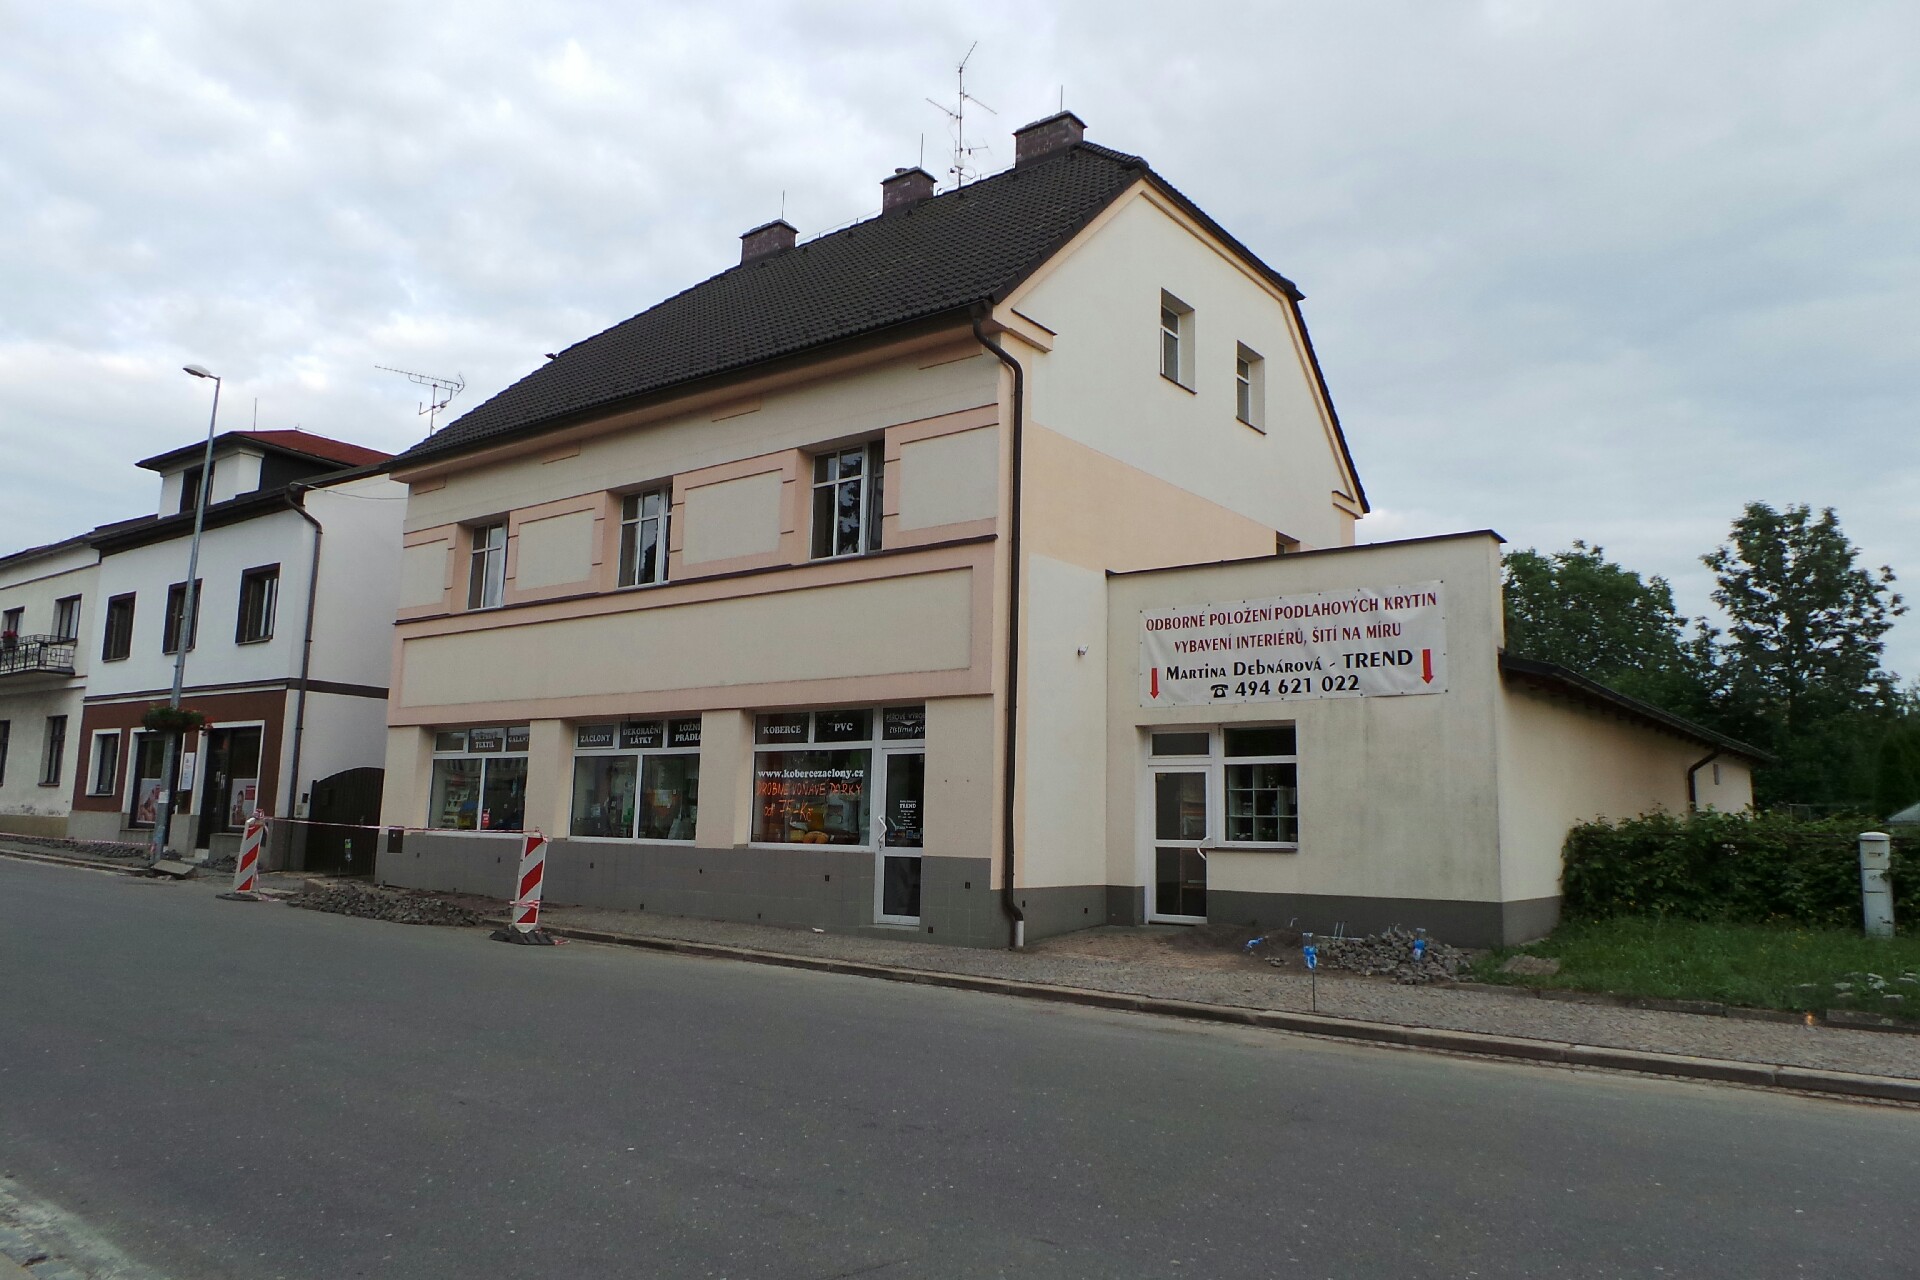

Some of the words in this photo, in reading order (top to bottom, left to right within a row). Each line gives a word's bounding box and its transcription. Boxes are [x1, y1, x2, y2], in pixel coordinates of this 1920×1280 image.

[1146, 611, 1206, 631] ODBORNÉ
[1209, 604, 1272, 626] POLOŽENÍ
[1275, 595, 1379, 620] PODLAHOVÝCH
[1384, 591, 1437, 610] KRYTIN
[1174, 633, 1232, 653] VYBAVENÍ
[1312, 624, 1337, 643] ŠITÍ
[1342, 626, 1361, 641] NA
[1366, 620, 1402, 639] MÍRU
[1342, 649, 1413, 669] TREND
[1235, 680, 1271, 696] 494
[1277, 677, 1311, 695] 621
[1322, 674, 1360, 692] 022
[763, 725, 802, 734] KOBERCE
[834, 722, 853, 732] PVC
[630, 734, 653, 745] LÁTKY
[758, 768, 864, 779] www.kobercezaclony.cz
